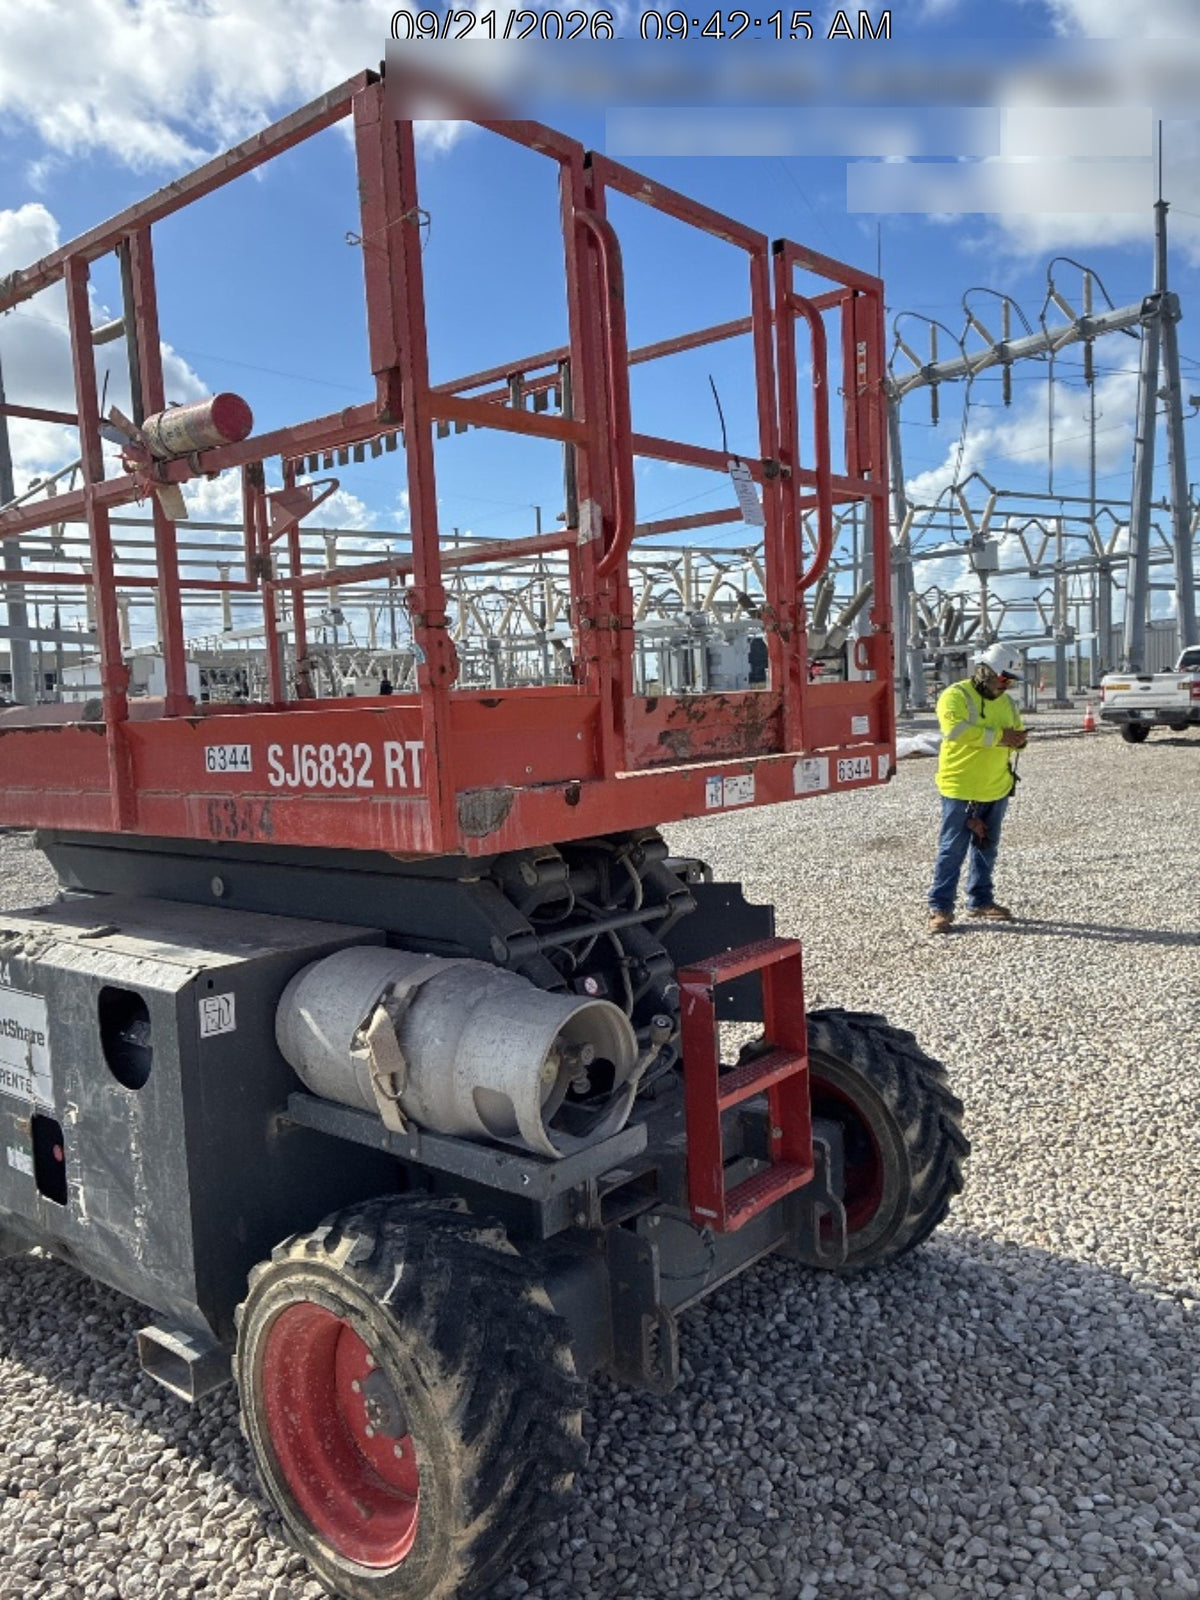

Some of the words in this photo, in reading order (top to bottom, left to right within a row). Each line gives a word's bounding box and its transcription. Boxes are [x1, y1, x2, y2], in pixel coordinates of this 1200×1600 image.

[207, 746, 250, 770] 6344
[267, 743, 374, 788] SJ6832
[383, 741, 424, 788] RT
[838, 759, 871, 781] 6344
